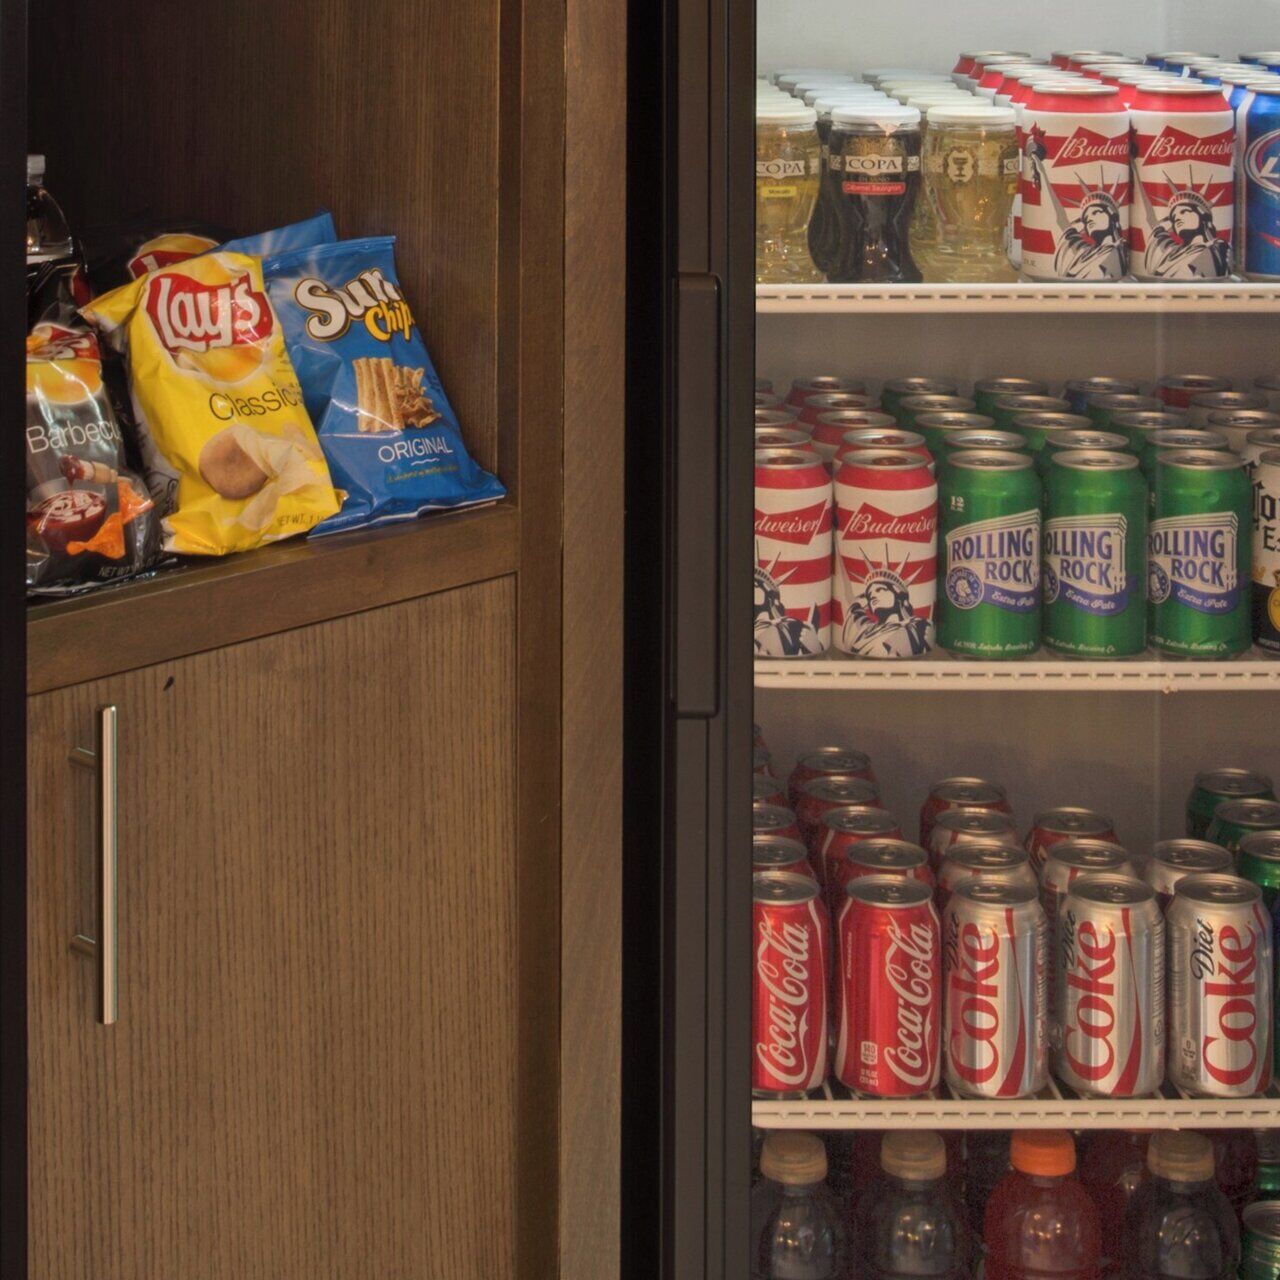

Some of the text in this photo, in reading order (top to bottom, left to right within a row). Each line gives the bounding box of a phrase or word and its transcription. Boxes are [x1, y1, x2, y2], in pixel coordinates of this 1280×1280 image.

[848, 157, 898, 172] COPA
[1147, 136, 1234, 160] Budweise
[157, 272, 261, 352] Lay's
[365, 300, 415, 342] Chip
[209, 383, 302, 421] Classic
[26, 419, 119, 454] Barbecu
[378, 437, 454, 463] ORIGINAL
[951, 527, 1034, 562] ROLLING
[984, 559, 1033, 585] ROCK
[1060, 558, 1112, 588] ROCK
[1171, 558, 1224, 587] ROCK
[991, 589, 1015, 605] Extra
[1065, 589, 1091, 609] Extra
[1177, 588, 1202, 608] Extra
[1190, 918, 1216, 980] Diet
[756, 910, 810, 1086] Coca-Cola
[884, 911, 933, 1087] Coca-Cola
[951, 922, 1000, 1084] Coke
[1066, 921, 1116, 1082] Coke
[1202, 924, 1257, 1085] Coke
